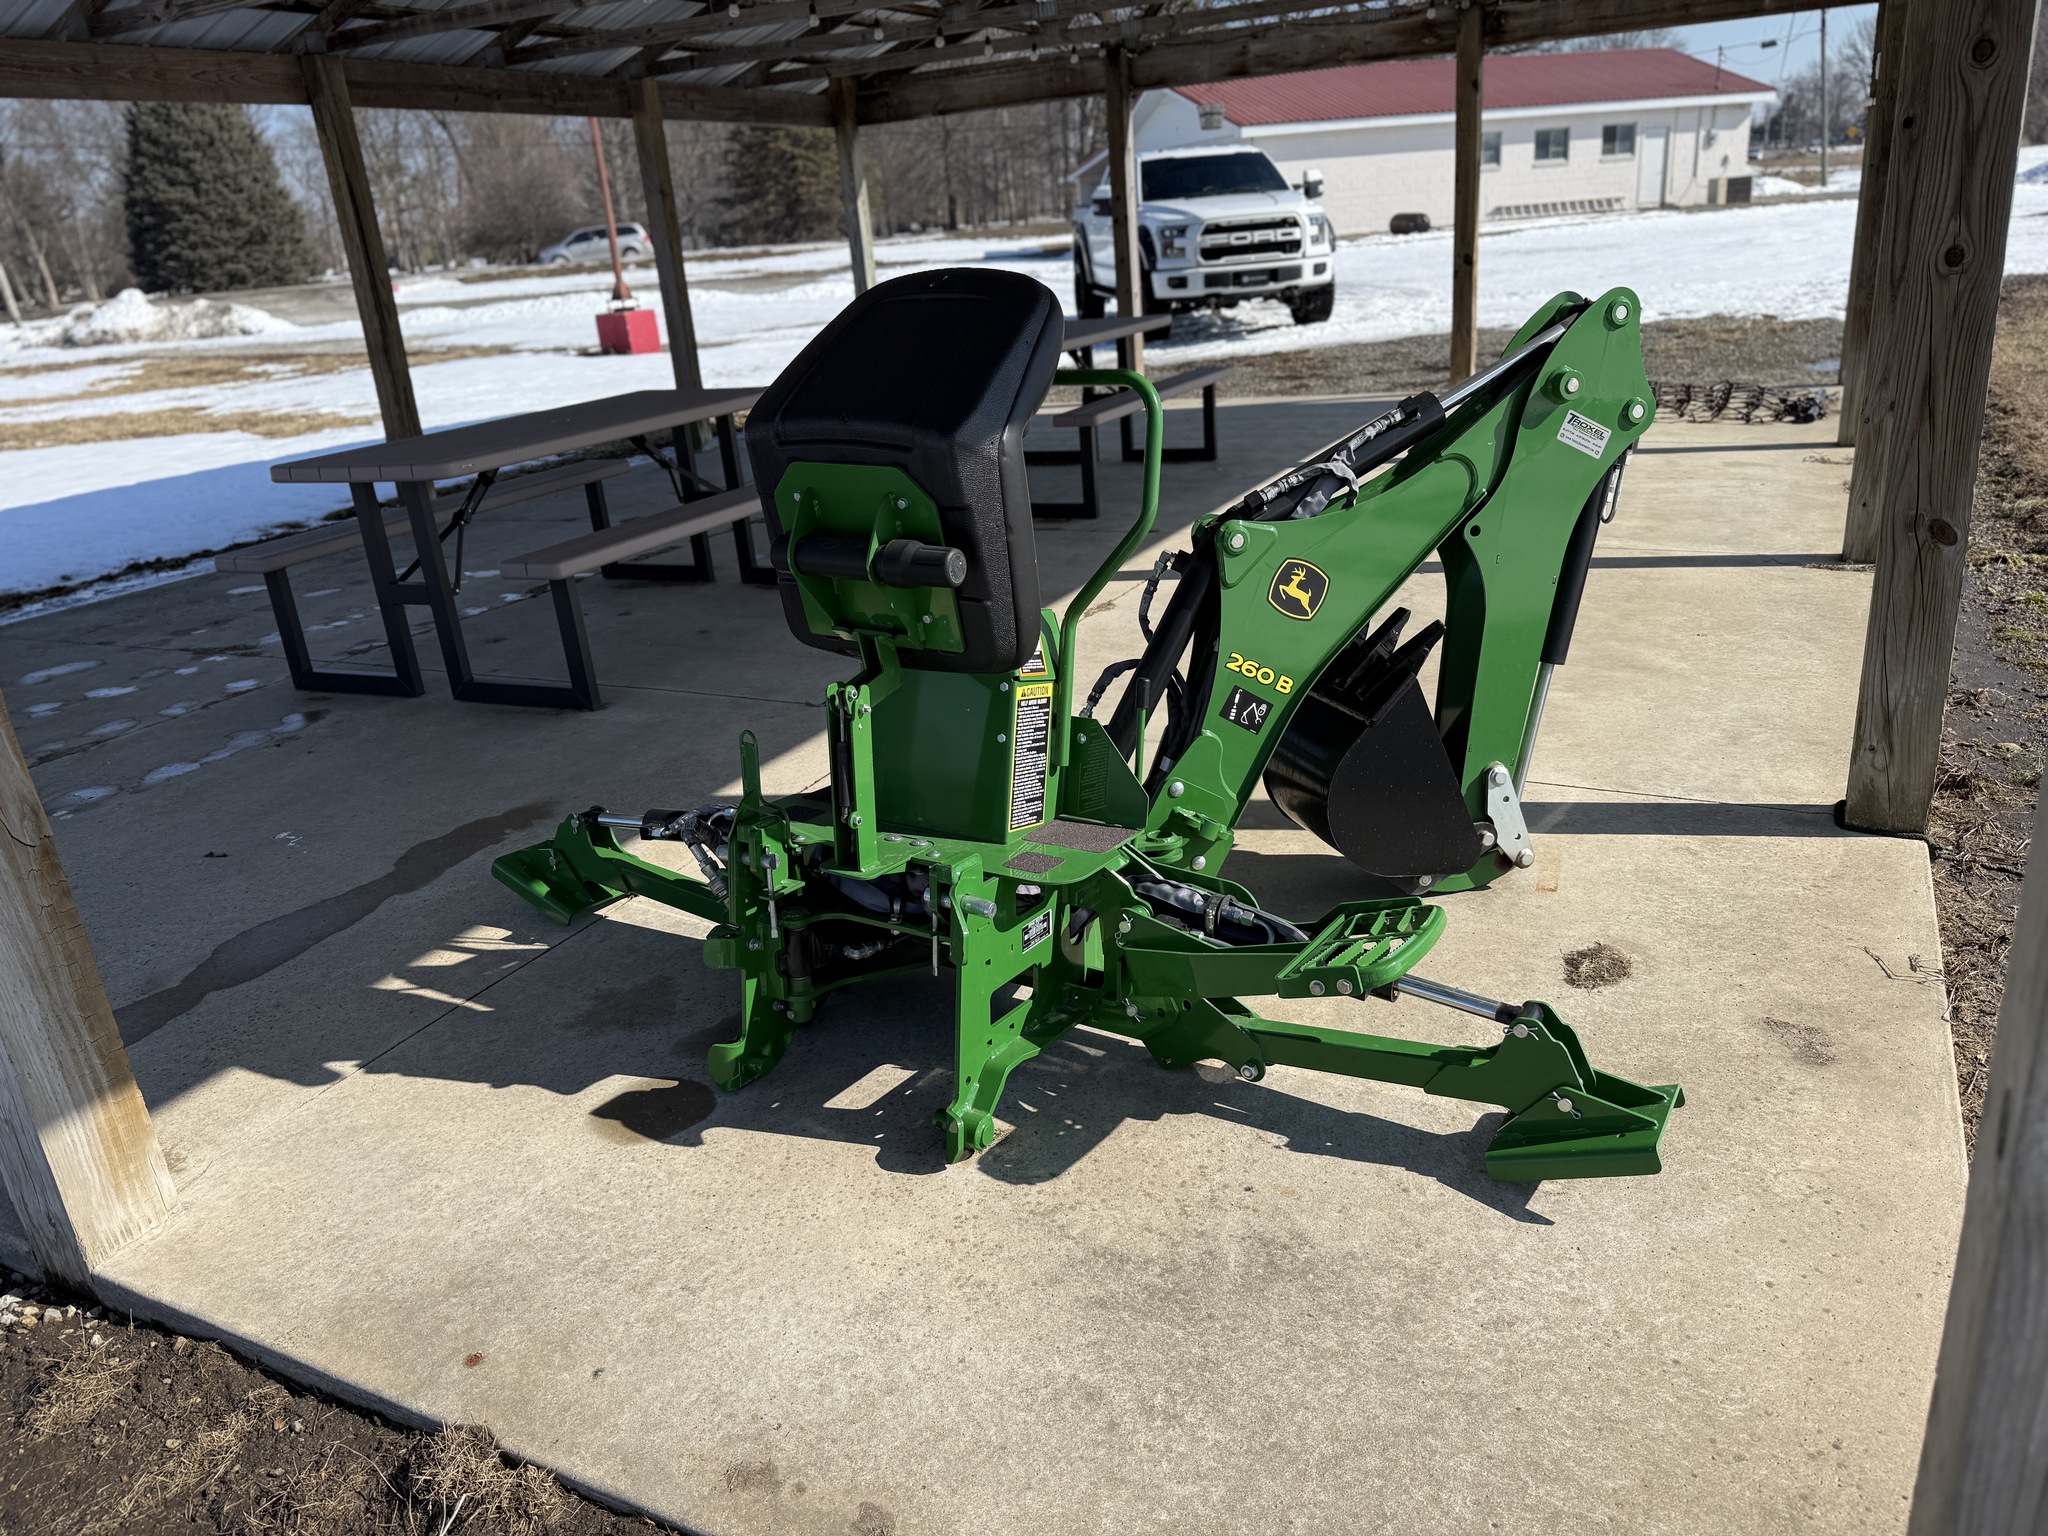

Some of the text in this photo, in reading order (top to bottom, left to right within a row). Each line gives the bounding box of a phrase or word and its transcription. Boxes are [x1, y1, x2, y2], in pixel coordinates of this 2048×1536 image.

[1200, 227, 1301, 249] FORD
[1567, 413, 1605, 438] TROXEL
[1225, 652, 1294, 694] 260 B
[1026, 686, 1049, 697] CAUTION
